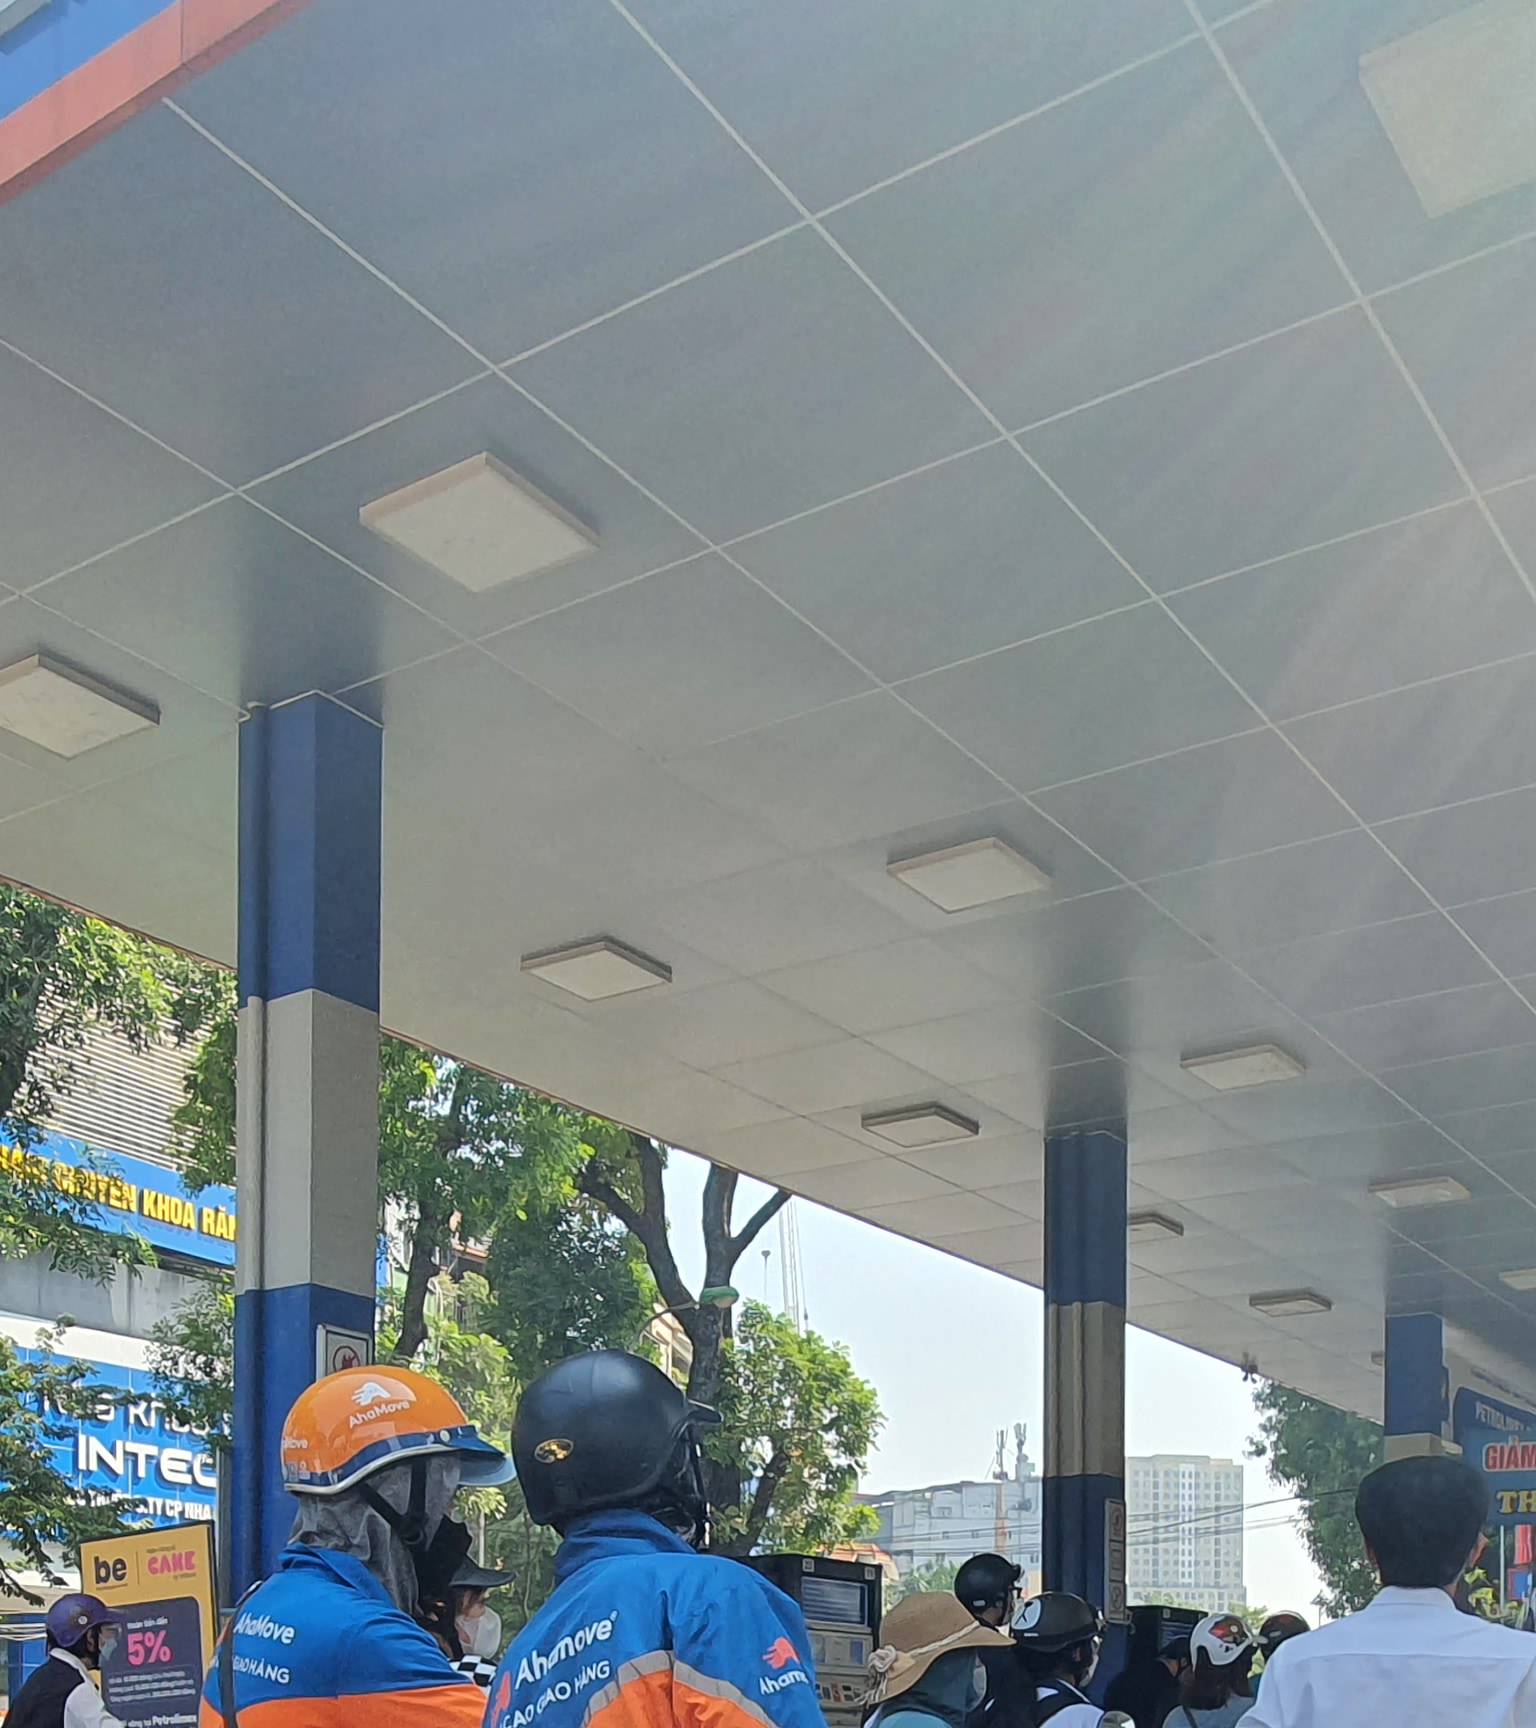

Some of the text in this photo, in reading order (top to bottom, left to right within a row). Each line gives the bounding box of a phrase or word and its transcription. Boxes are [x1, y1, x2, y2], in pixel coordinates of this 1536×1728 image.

[143, 1187, 196, 1230] KHOA
[349, 1400, 410, 1429] AhaMove
[184, 1503, 213, 1520] NHA
[94, 1556, 127, 1584] be
[147, 1551, 196, 1575] CAKE
[233, 1612, 295, 1644] AhaMove
[127, 1630, 171, 1666] 5%
[515, 1617, 613, 1690] Ahamove
[248, 1658, 290, 1684] HÀNG
